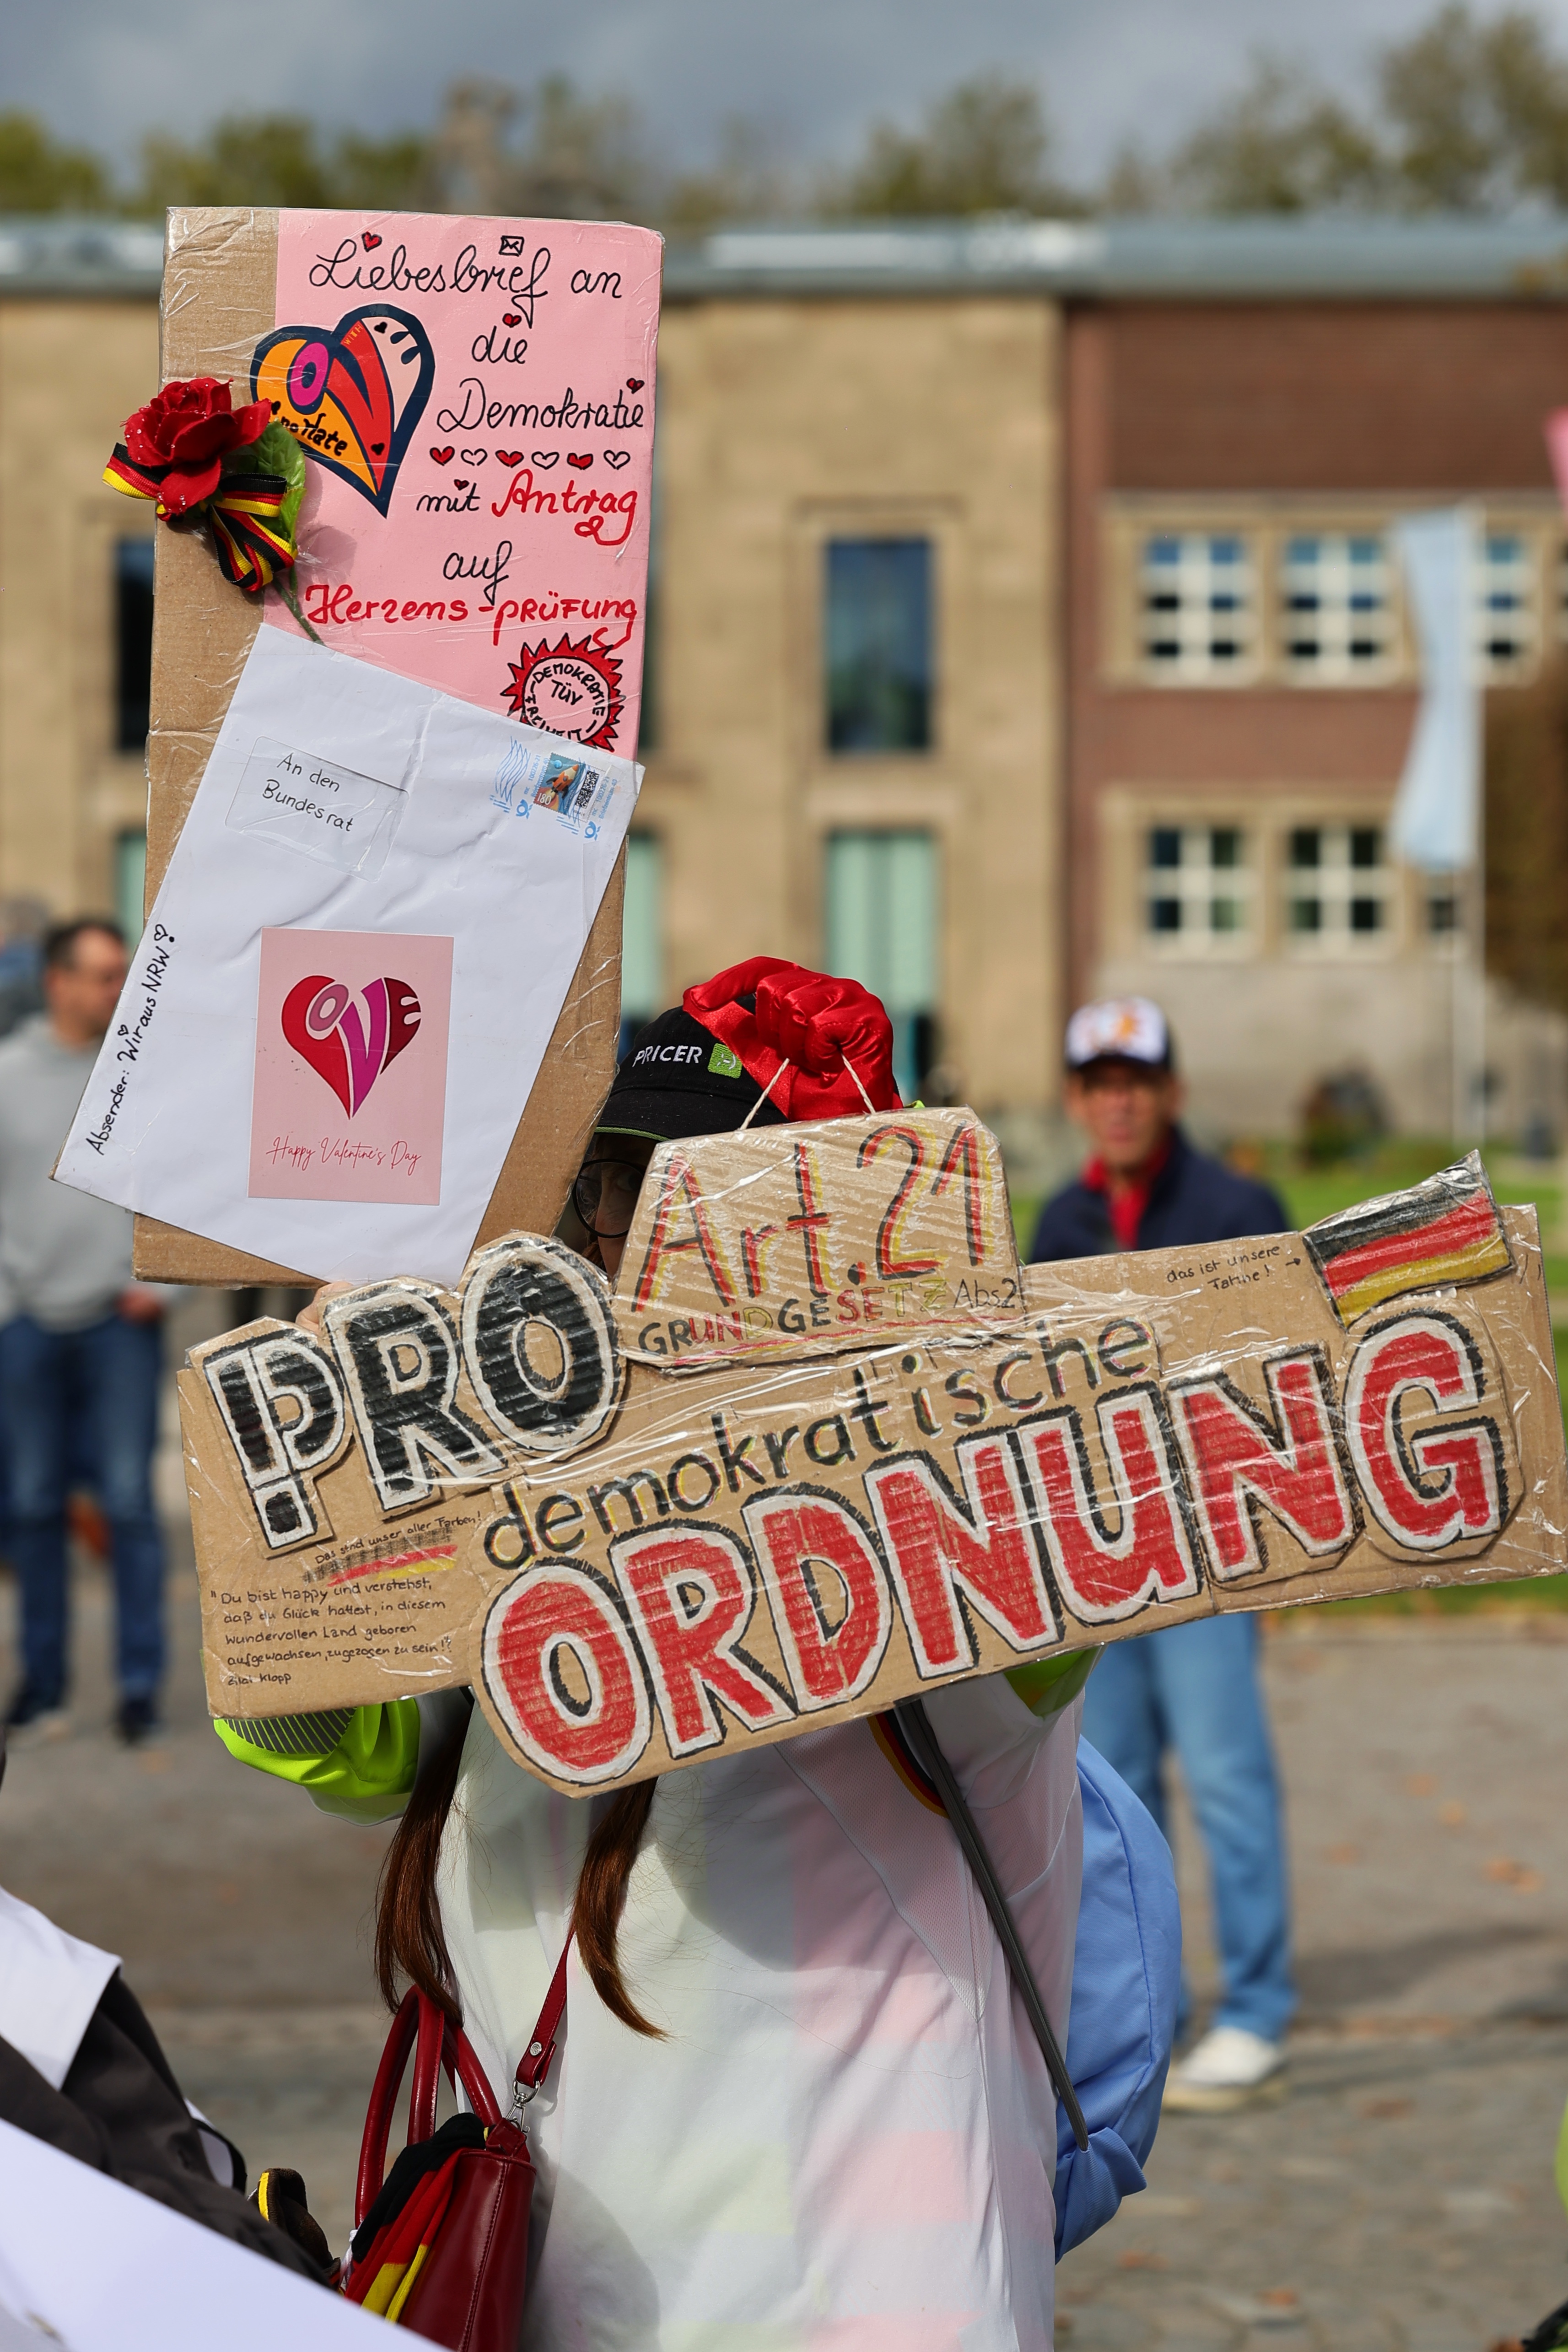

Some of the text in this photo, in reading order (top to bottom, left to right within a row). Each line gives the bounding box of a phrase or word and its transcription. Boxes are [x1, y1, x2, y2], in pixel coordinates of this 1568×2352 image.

[309, 238, 623, 329] Liebesbrief an
[344, 324, 363, 345] WITH
[472, 325, 528, 365] die
[436, 378, 644, 433] Demokratie
[416, 469, 638, 546] mit Antrag
[442, 540, 512, 606] auf
[305, 584, 469, 624] Herzens
[532, 663, 606, 716] DEMOKRATIE
[551, 679, 583, 706] TÜV
[276, 752, 340, 793] An den
[262, 779, 353, 832] Bundesrat
[537, 793, 552, 805] 180
[141, 946, 170, 993] NRW
[139, 997, 157, 1028] aus
[117, 1025, 144, 1062] Wir
[281, 975, 422, 1120] LOVE
[632, 1045, 703, 1068] PRICER
[265, 1136, 422, 1176] Happy Valentine's Day
[1167, 1246, 1280, 1283] das ist unsere
[638, 1278, 948, 1357] GRUNDGESETZ
[202, 1235, 623, 1551] PRO
[481, 1316, 1153, 1570] demokratische
[315, 1551, 336, 1564] Das
[368, 1530, 402, 1545] unser
[407, 1522, 431, 1534] aller
[478, 1306, 1511, 1785] ORDNUNG
[247, 1589, 277, 1602] bist
[281, 1588, 328, 1605] happy
[334, 1582, 361, 1596] und
[283, 1607, 319, 1620] Glück
[381, 1602, 393, 1611] in
[398, 1601, 446, 1610] diesem
[323, 1625, 357, 1638] Land
[364, 1624, 417, 1641] geboren
